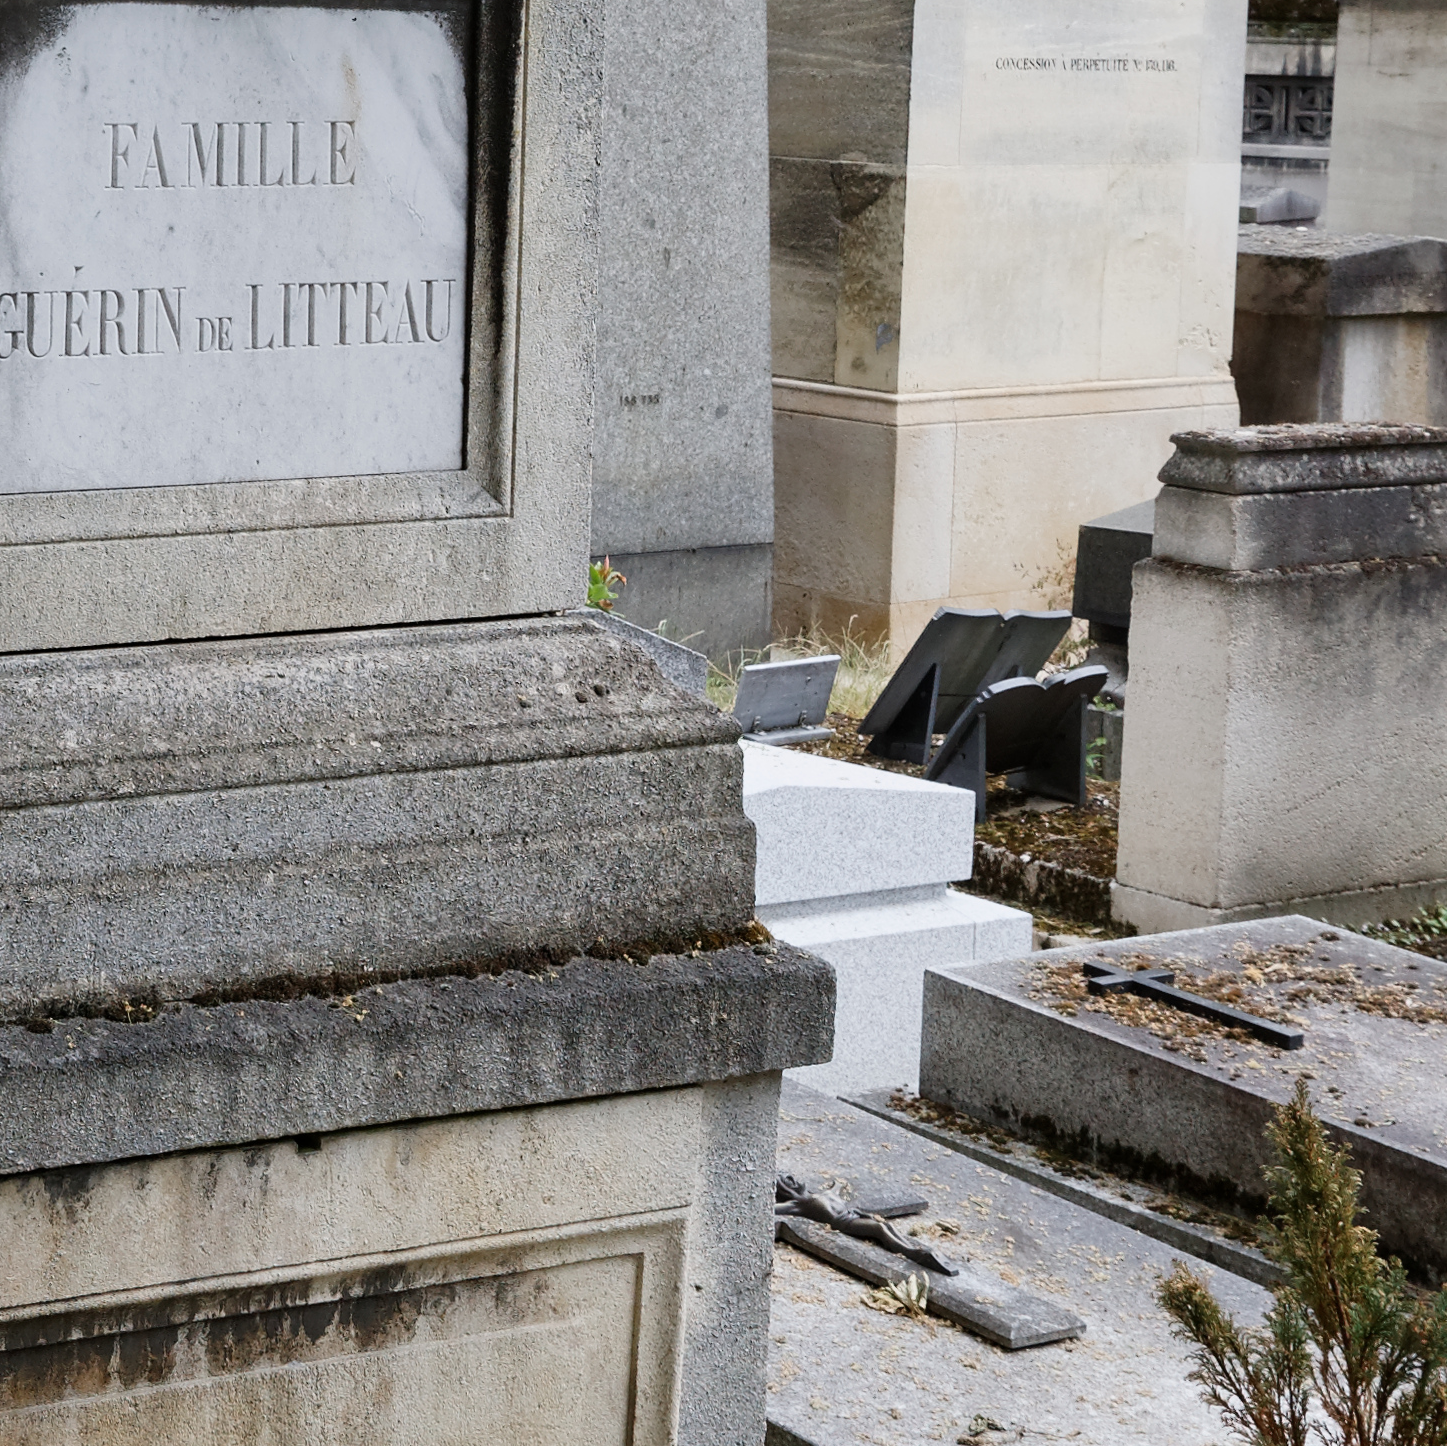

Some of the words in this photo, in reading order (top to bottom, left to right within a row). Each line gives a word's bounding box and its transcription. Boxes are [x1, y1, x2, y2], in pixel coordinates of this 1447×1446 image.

[994, 57, 1057, 71] CONCESSION
[103, 119, 358, 191] FAMILLE
[195, 315, 234, 353] DE
[243, 279, 456, 352] LITTEAU
